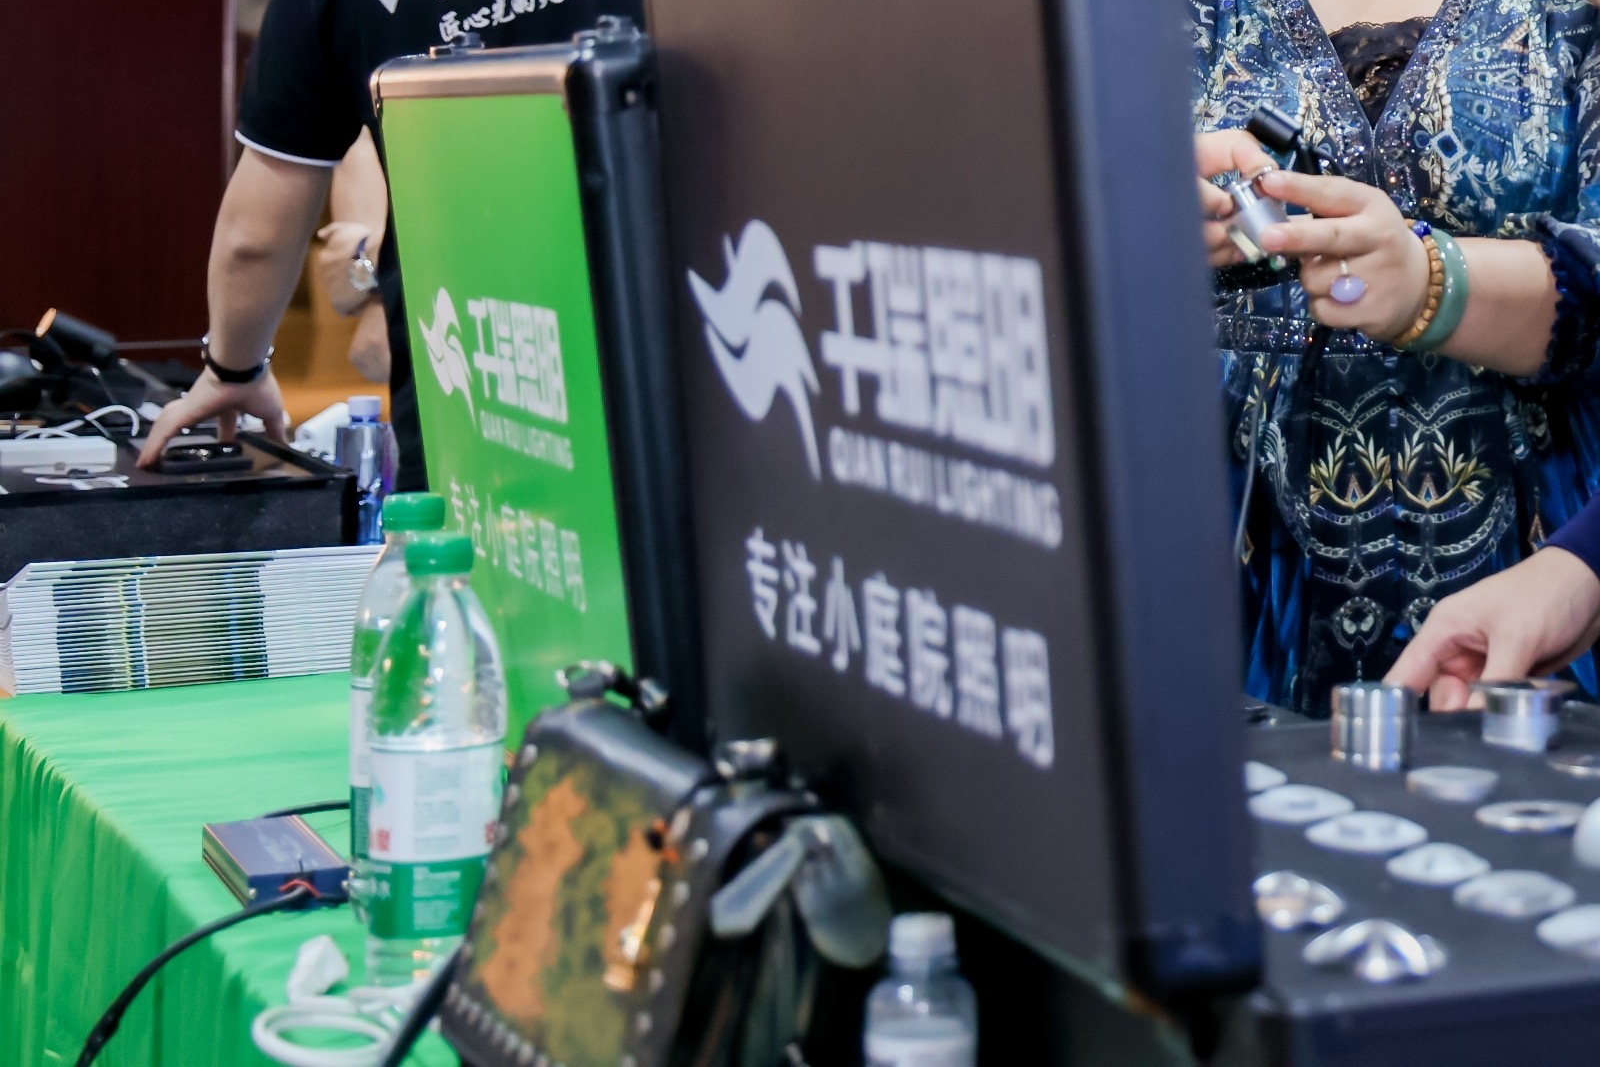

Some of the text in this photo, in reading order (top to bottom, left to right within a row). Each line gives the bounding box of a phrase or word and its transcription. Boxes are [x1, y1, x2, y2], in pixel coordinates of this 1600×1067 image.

[746, 527, 1055, 768] 专注小庭院照明
